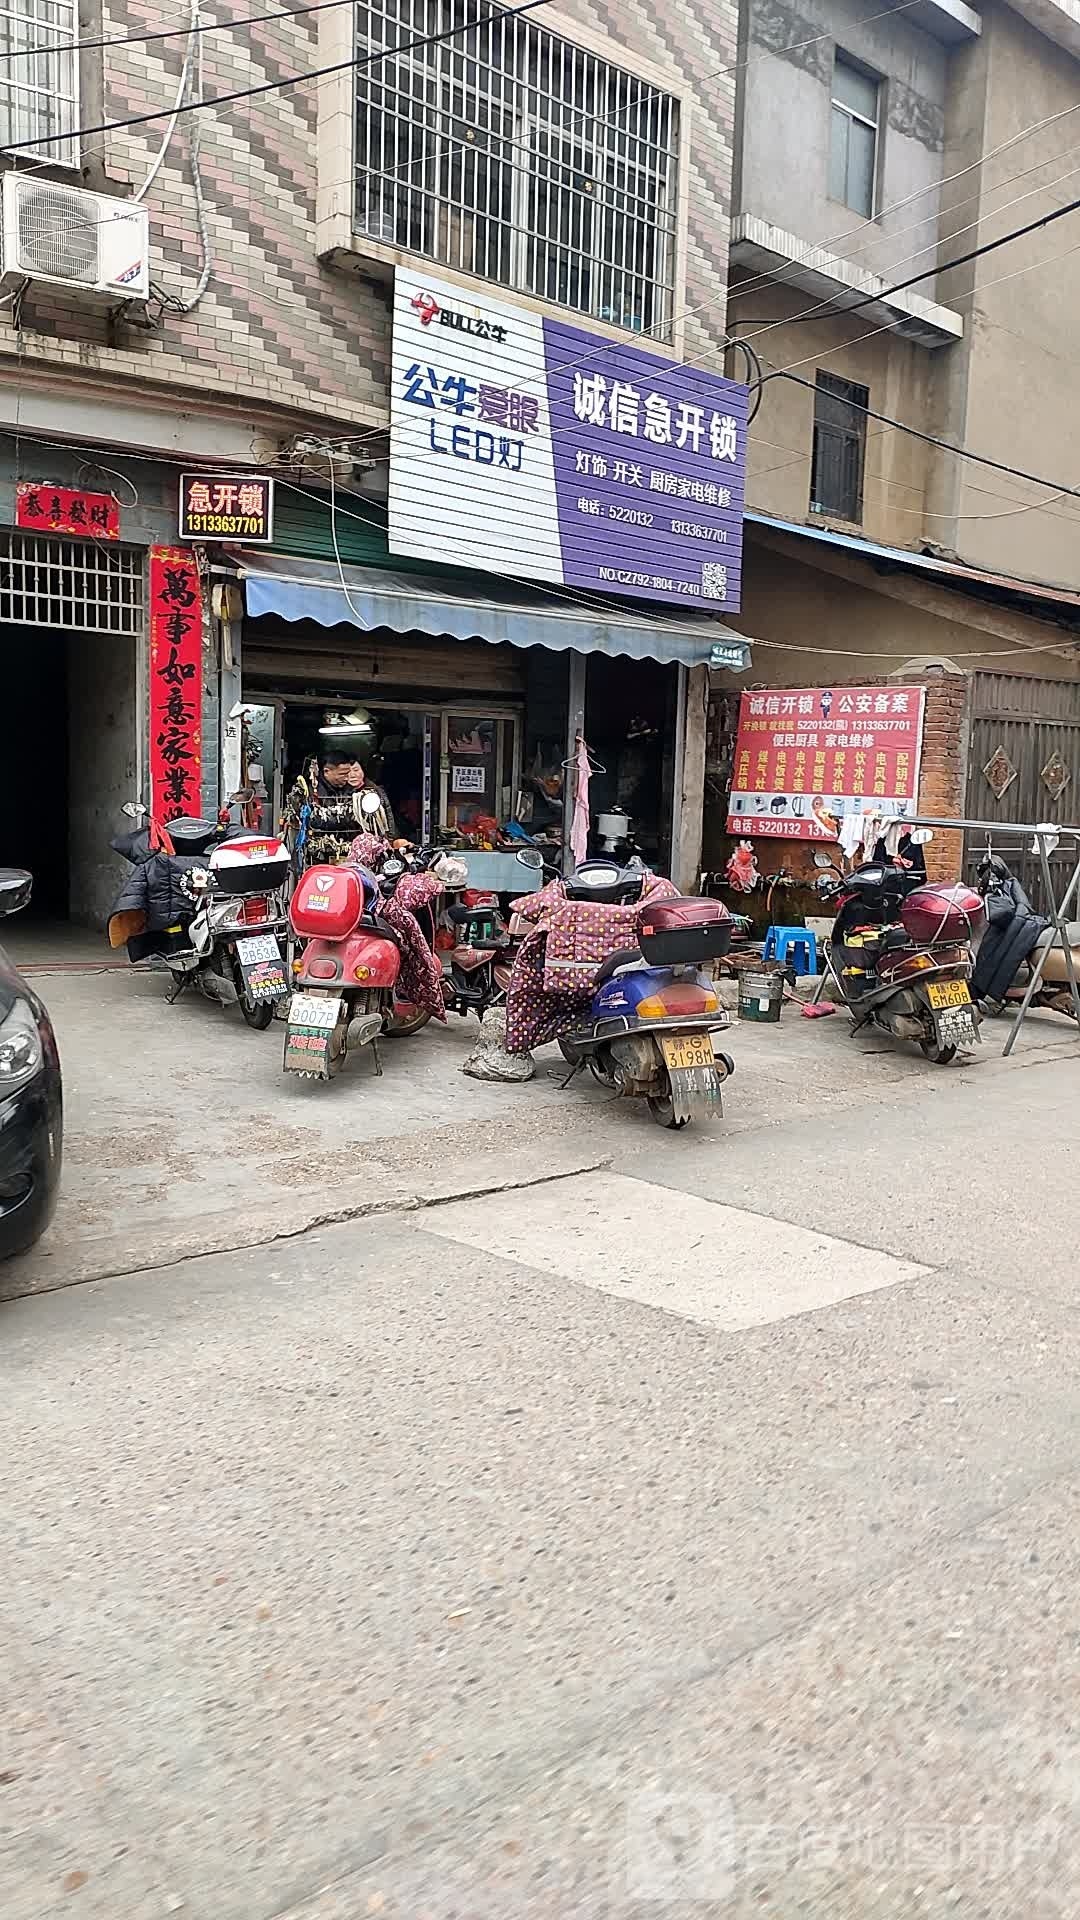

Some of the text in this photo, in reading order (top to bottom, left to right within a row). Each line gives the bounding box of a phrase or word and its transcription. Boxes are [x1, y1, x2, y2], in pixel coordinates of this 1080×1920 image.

[402, 363, 539, 433] 公牛爱眼
[573, 372, 737, 462] 诚信急开锁
[431, 417, 524, 471] LED灯
[575, 450, 732, 508] 灯饰 开关 厨房家电维修
[186, 514, 264, 535] 13133637701
[671, 520, 727, 543] 13133637701
[750, 693, 910, 715] 诚信开锁 公安备案
[773, 733, 874, 748] 便民厨具 家电维修
[852, 720, 911, 731] 13133637701
[737, 750, 750, 790] 高压锅
[755, 750, 769, 790] 煤气灶
[773, 751, 787, 791] 电饭煲
[792, 751, 806, 792] 电水壶
[812, 751, 825, 793] 取暖器
[832, 751, 846, 793] 脱水机
[852, 752, 866, 794] 饮水机
[872, 752, 887, 795] 电风扇
[894, 752, 909, 796] 配钥匙
[292, 1008, 334, 1025] 9007P
[932, 992, 969, 1007] 5M608
[669, 1049, 713, 1067] 3198M
